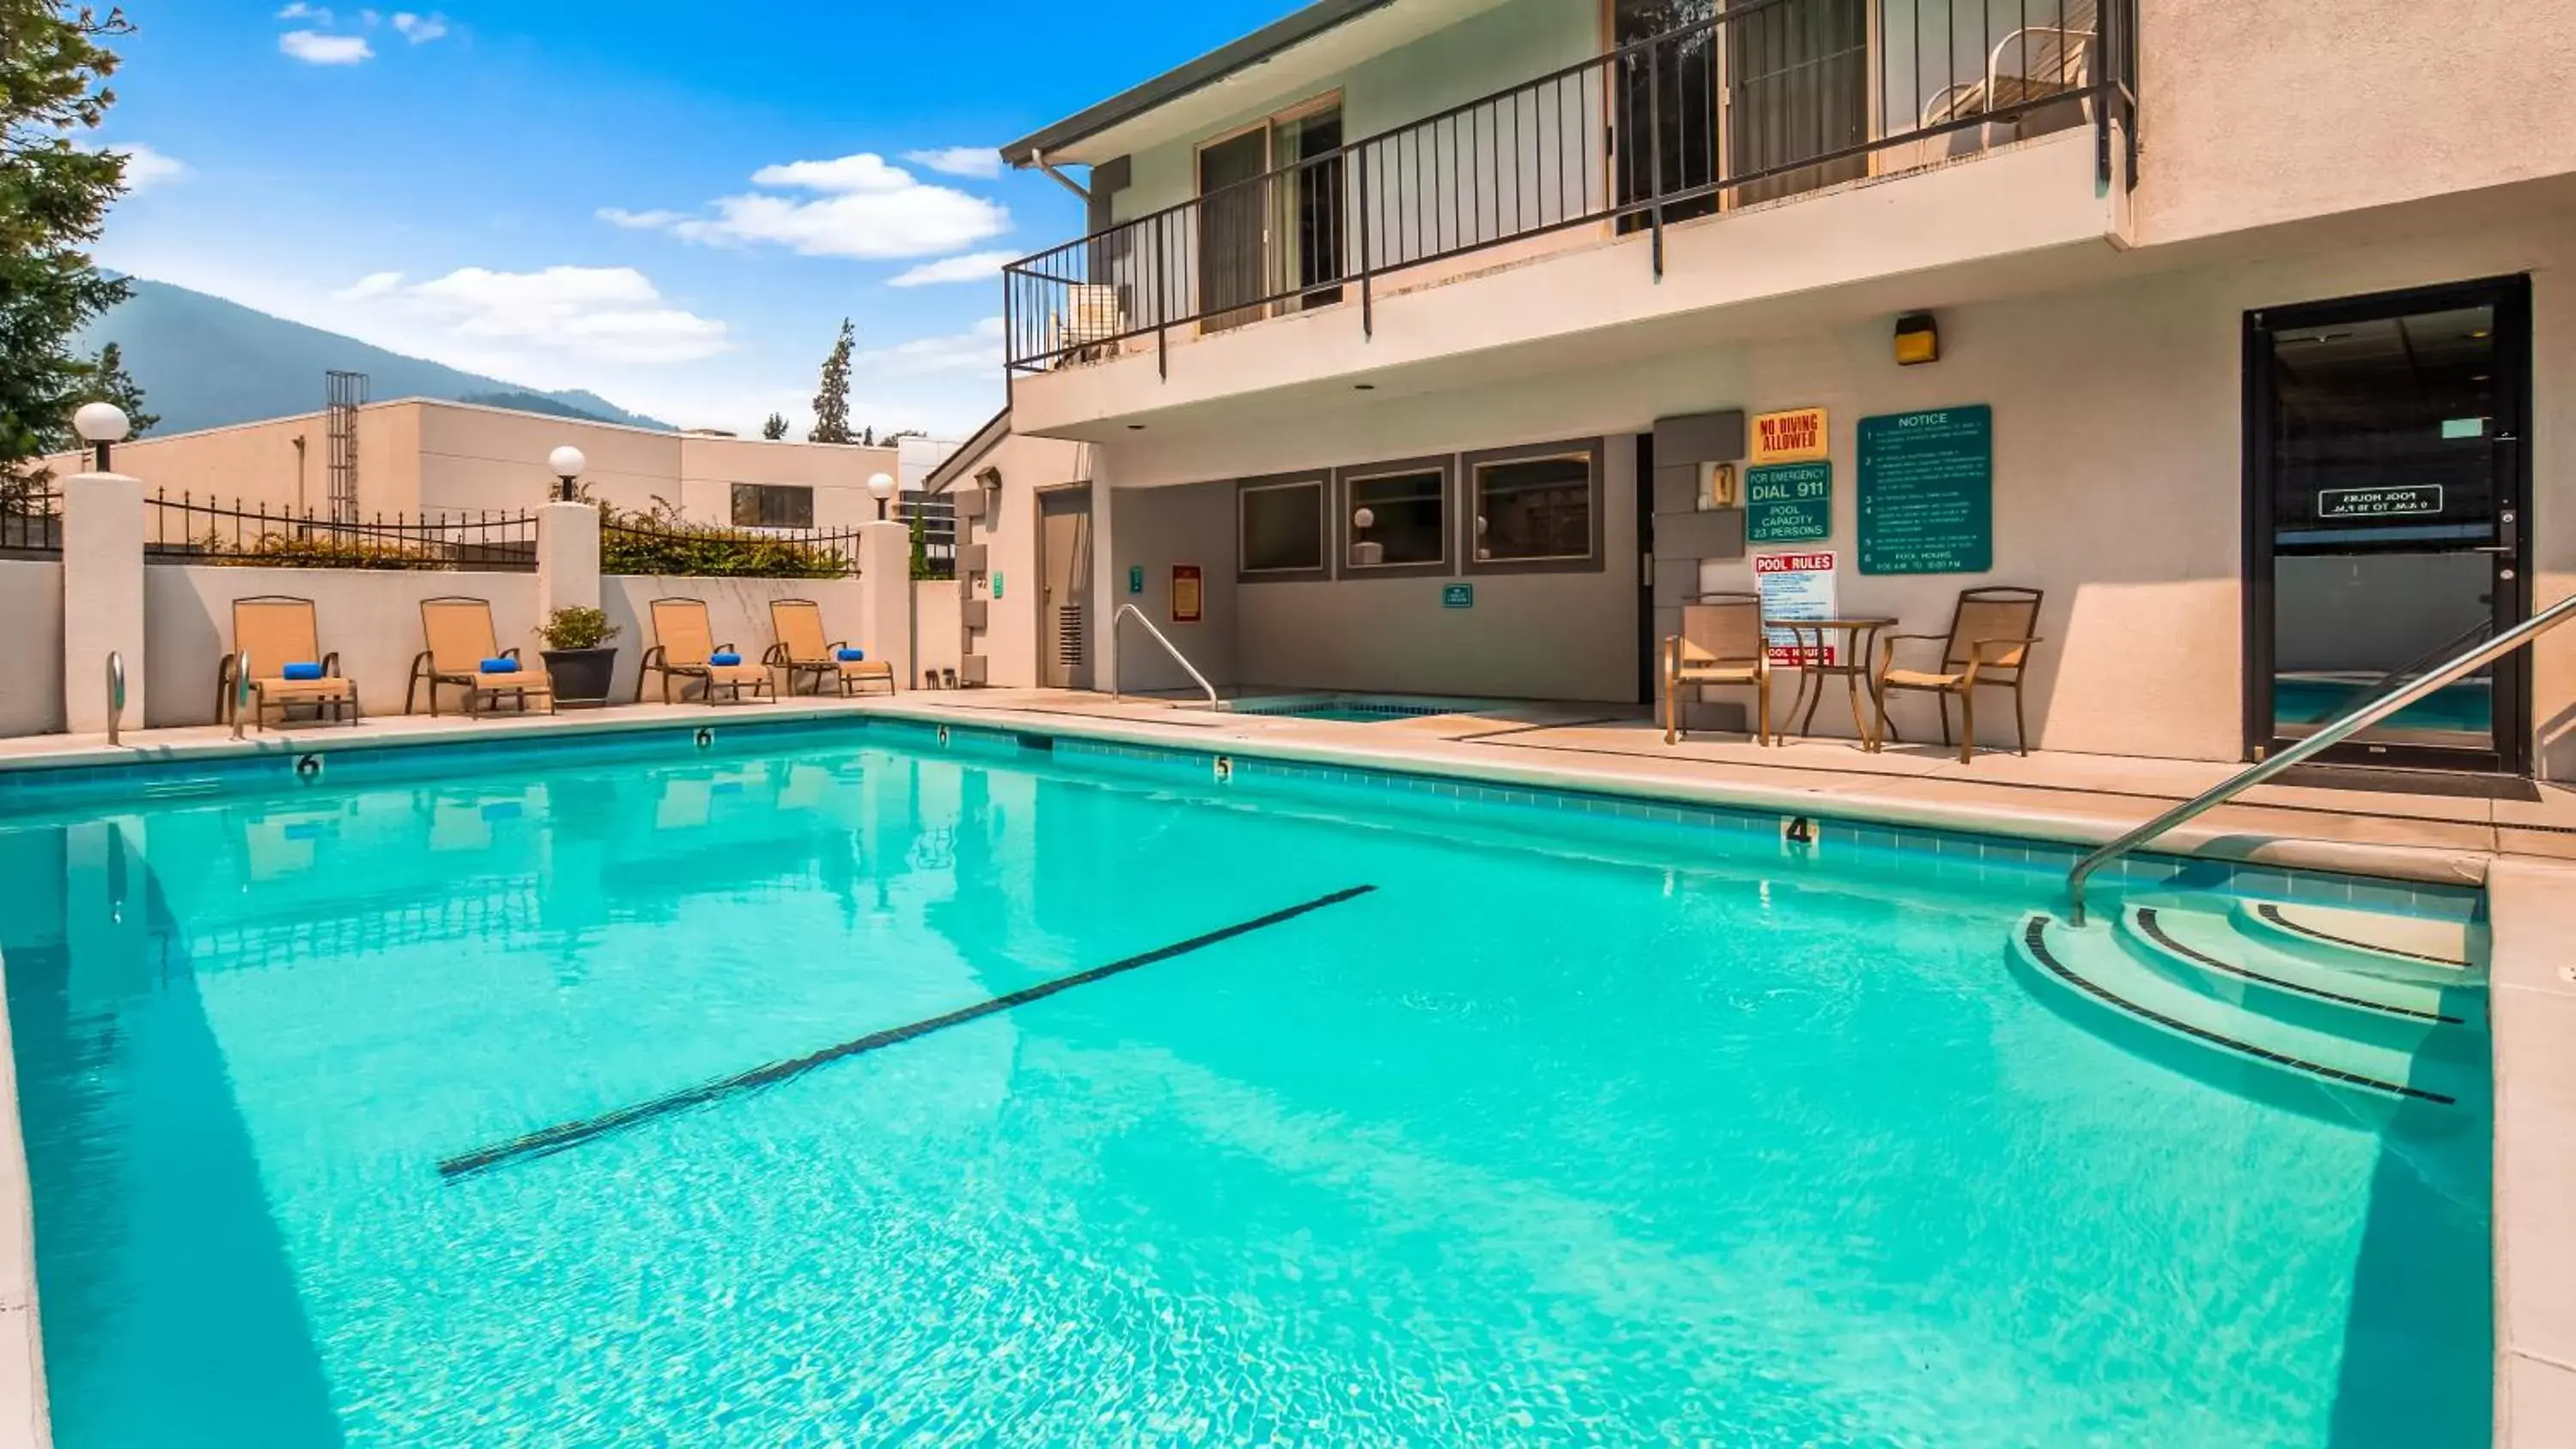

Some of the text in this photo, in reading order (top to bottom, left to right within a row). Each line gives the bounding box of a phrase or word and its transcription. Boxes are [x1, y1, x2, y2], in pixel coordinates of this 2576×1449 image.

[1759, 414, 1818, 435] NO DIVING
[1899, 413, 1947, 427] NOTICE
[1763, 430, 1816, 452] ALLOWED
[1750, 469, 1825, 485] FOR EMERGENCY
[1753, 482, 1824, 501] DIAL 911
[1770, 506, 1800, 516] POOL
[1761, 514, 1814, 528] CAPACITY
[1771, 524, 1824, 537] PERSONS
[1758, 556, 1830, 571] POOL RULES
[1769, 648, 1789, 657] OOL
[696, 725, 712, 748] 6
[939, 724, 947, 745] 6
[297, 755, 319, 778] 6
[1218, 756, 1229, 781] 5
[1785, 817, 1813, 843] 4
